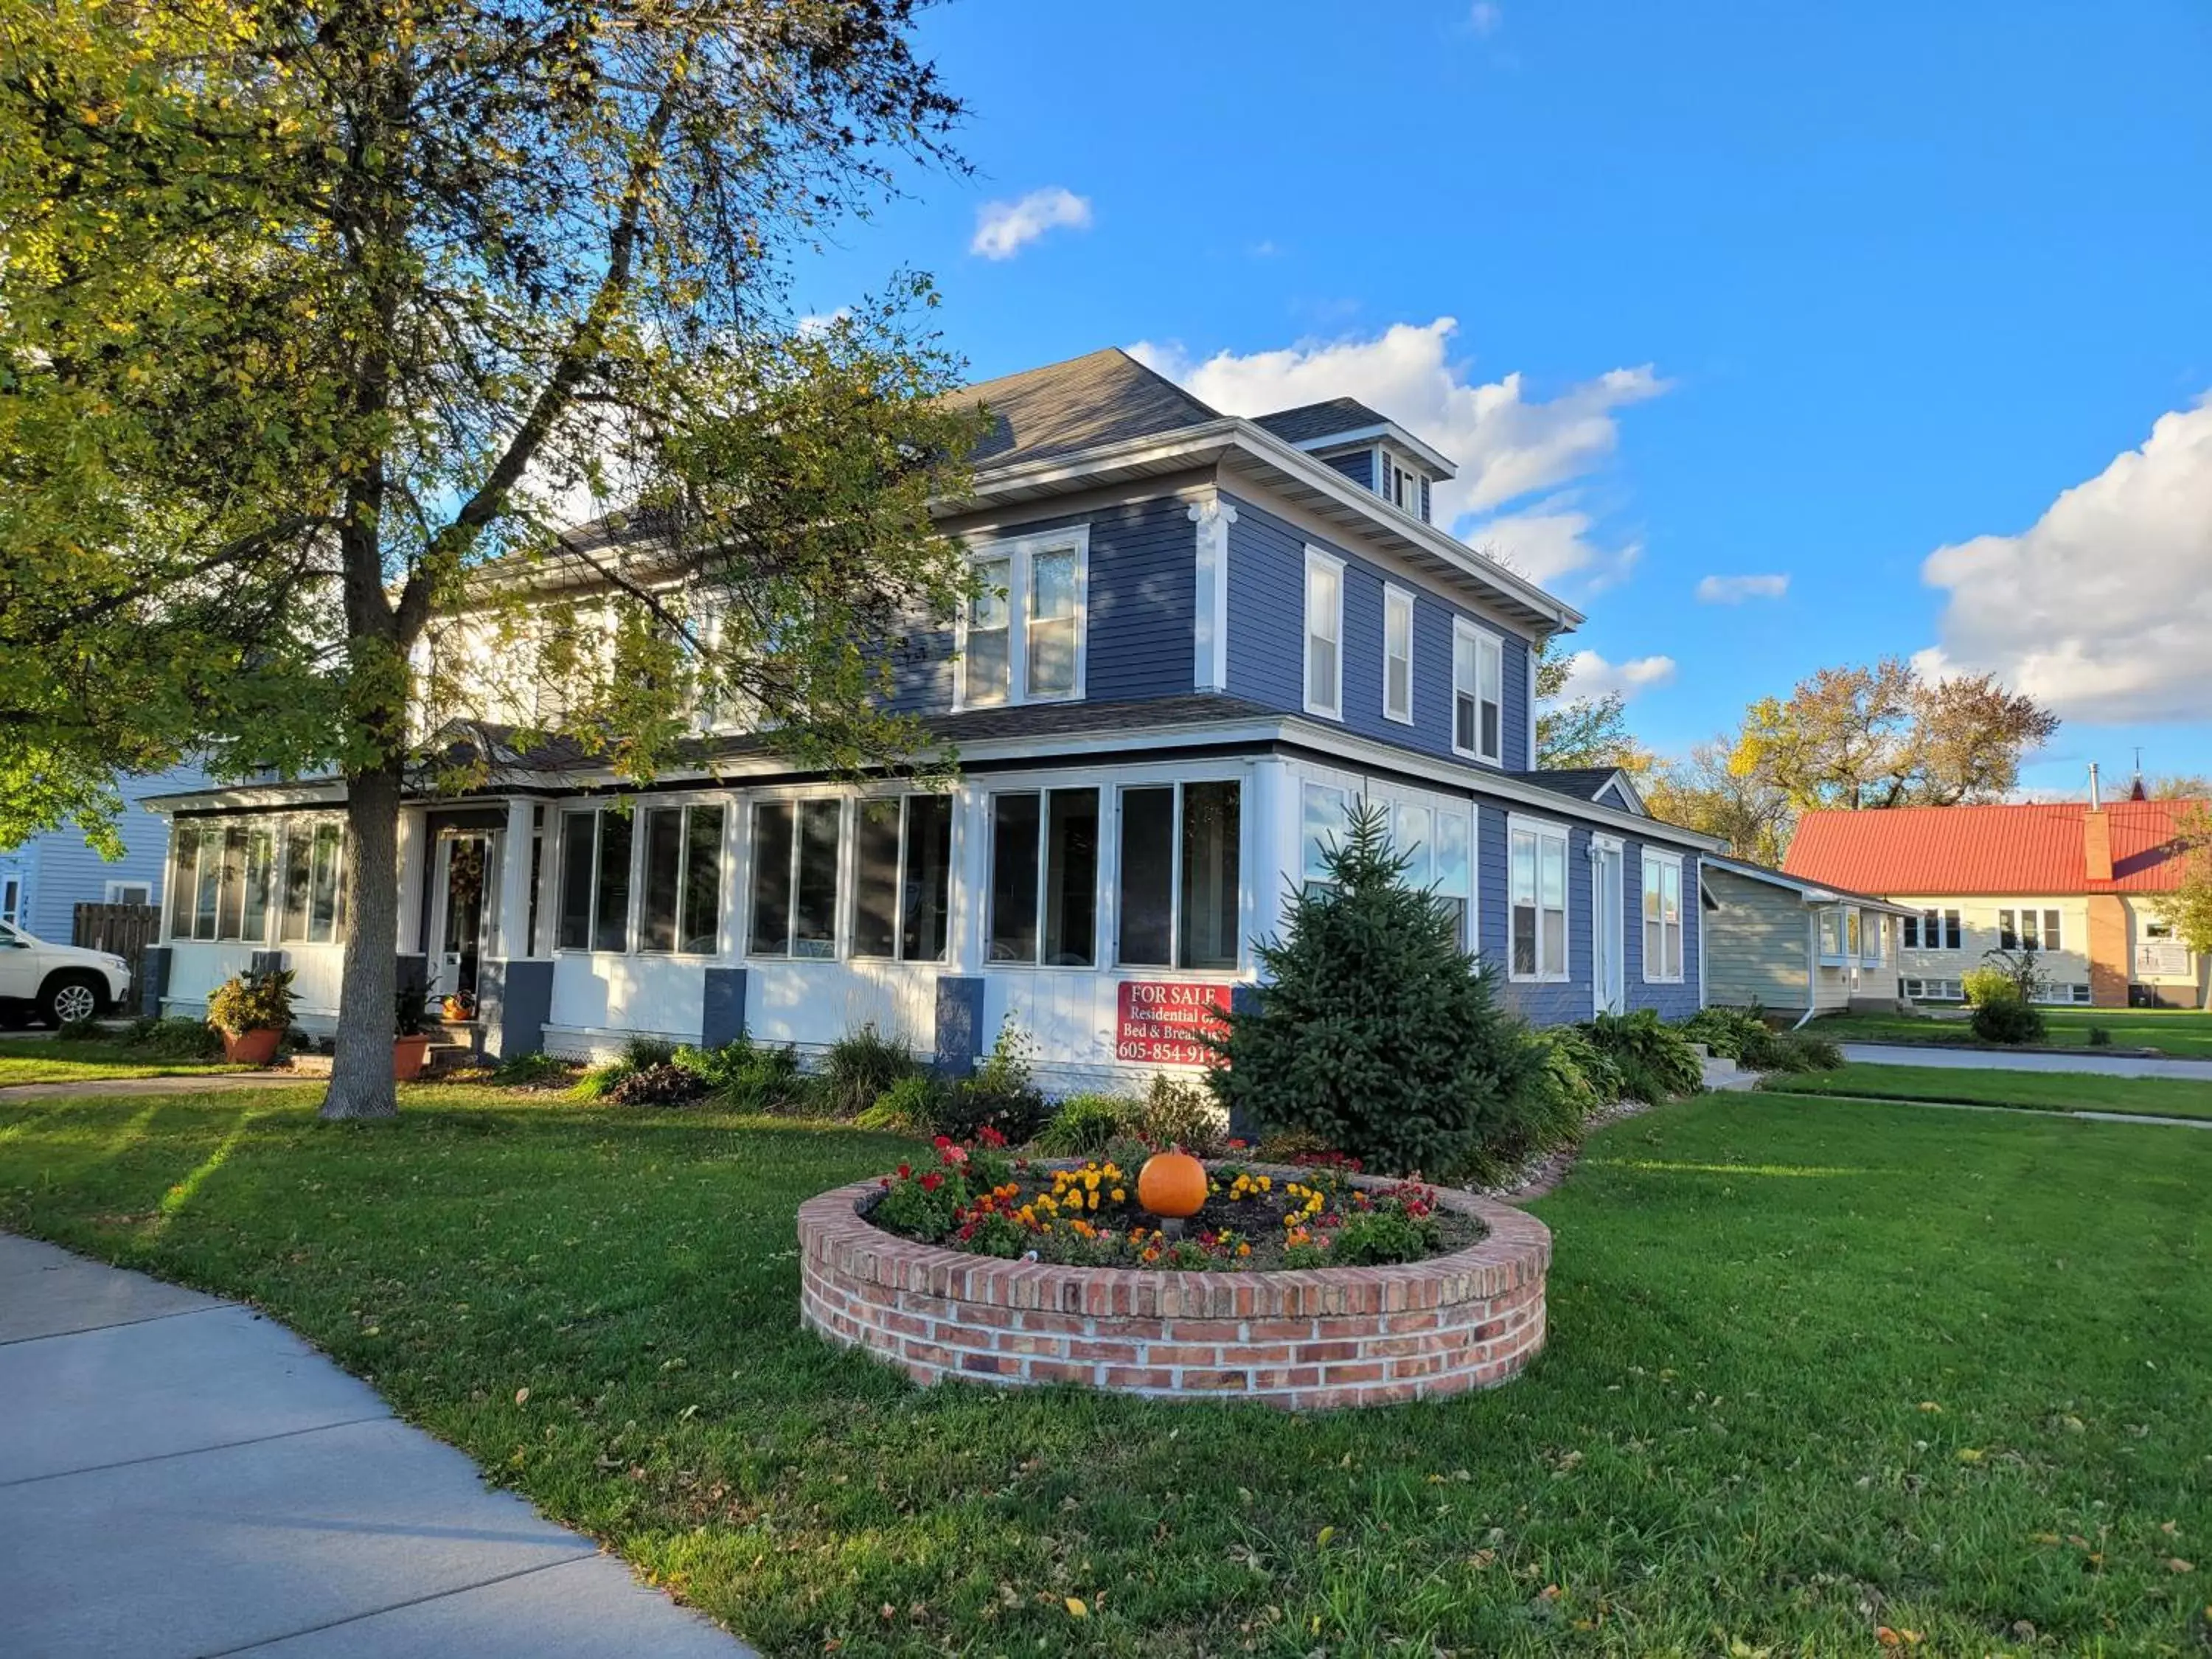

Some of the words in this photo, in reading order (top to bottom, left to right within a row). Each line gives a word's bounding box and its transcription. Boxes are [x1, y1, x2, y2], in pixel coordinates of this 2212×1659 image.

[1132, 985, 1167, 1004] FOR
[1171, 987, 1216, 1005] SALE
[1131, 1006, 1198, 1023] Residential
[1124, 1023, 1146, 1038] Bed
[1150, 1024, 1160, 1039] &
[1164, 1024, 1220, 1043] Breafs
